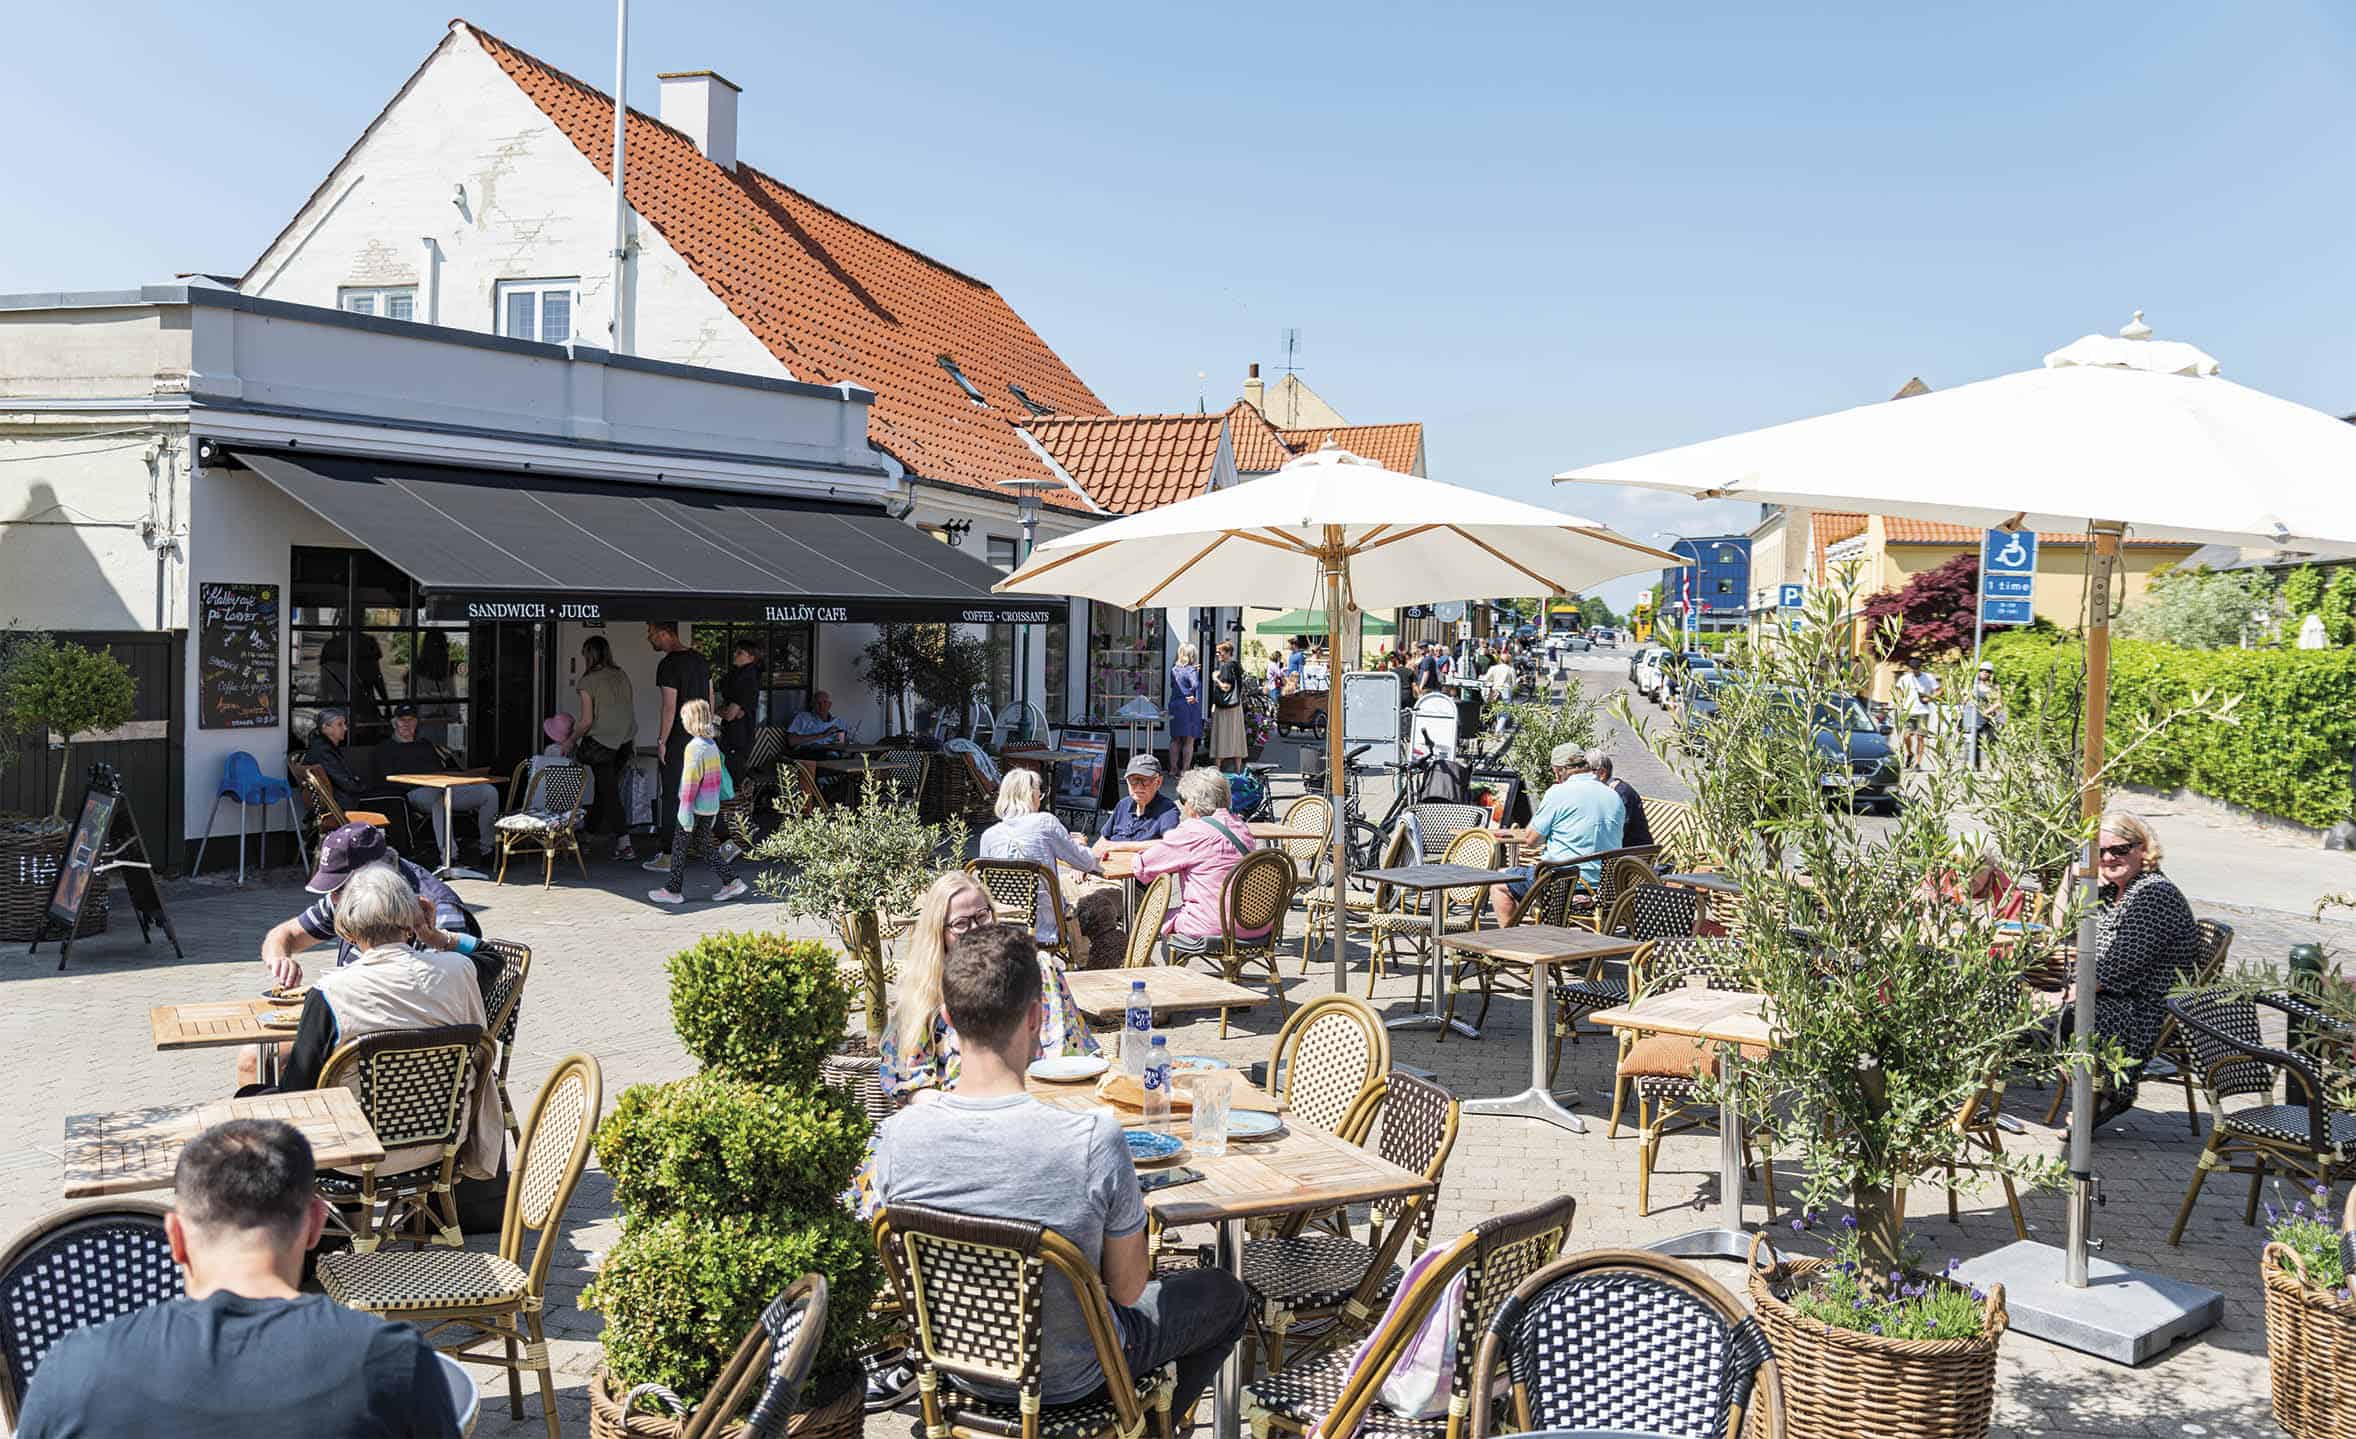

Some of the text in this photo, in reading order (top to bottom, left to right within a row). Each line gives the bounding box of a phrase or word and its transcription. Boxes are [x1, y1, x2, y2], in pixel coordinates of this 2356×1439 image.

[1785, 588, 1798, 605] P
[468, 603, 601, 618] SANDWICH JUICE
[765, 603, 815, 621] HALLÖY
[962, 610, 1050, 622] COFFEE CROISSANTS
